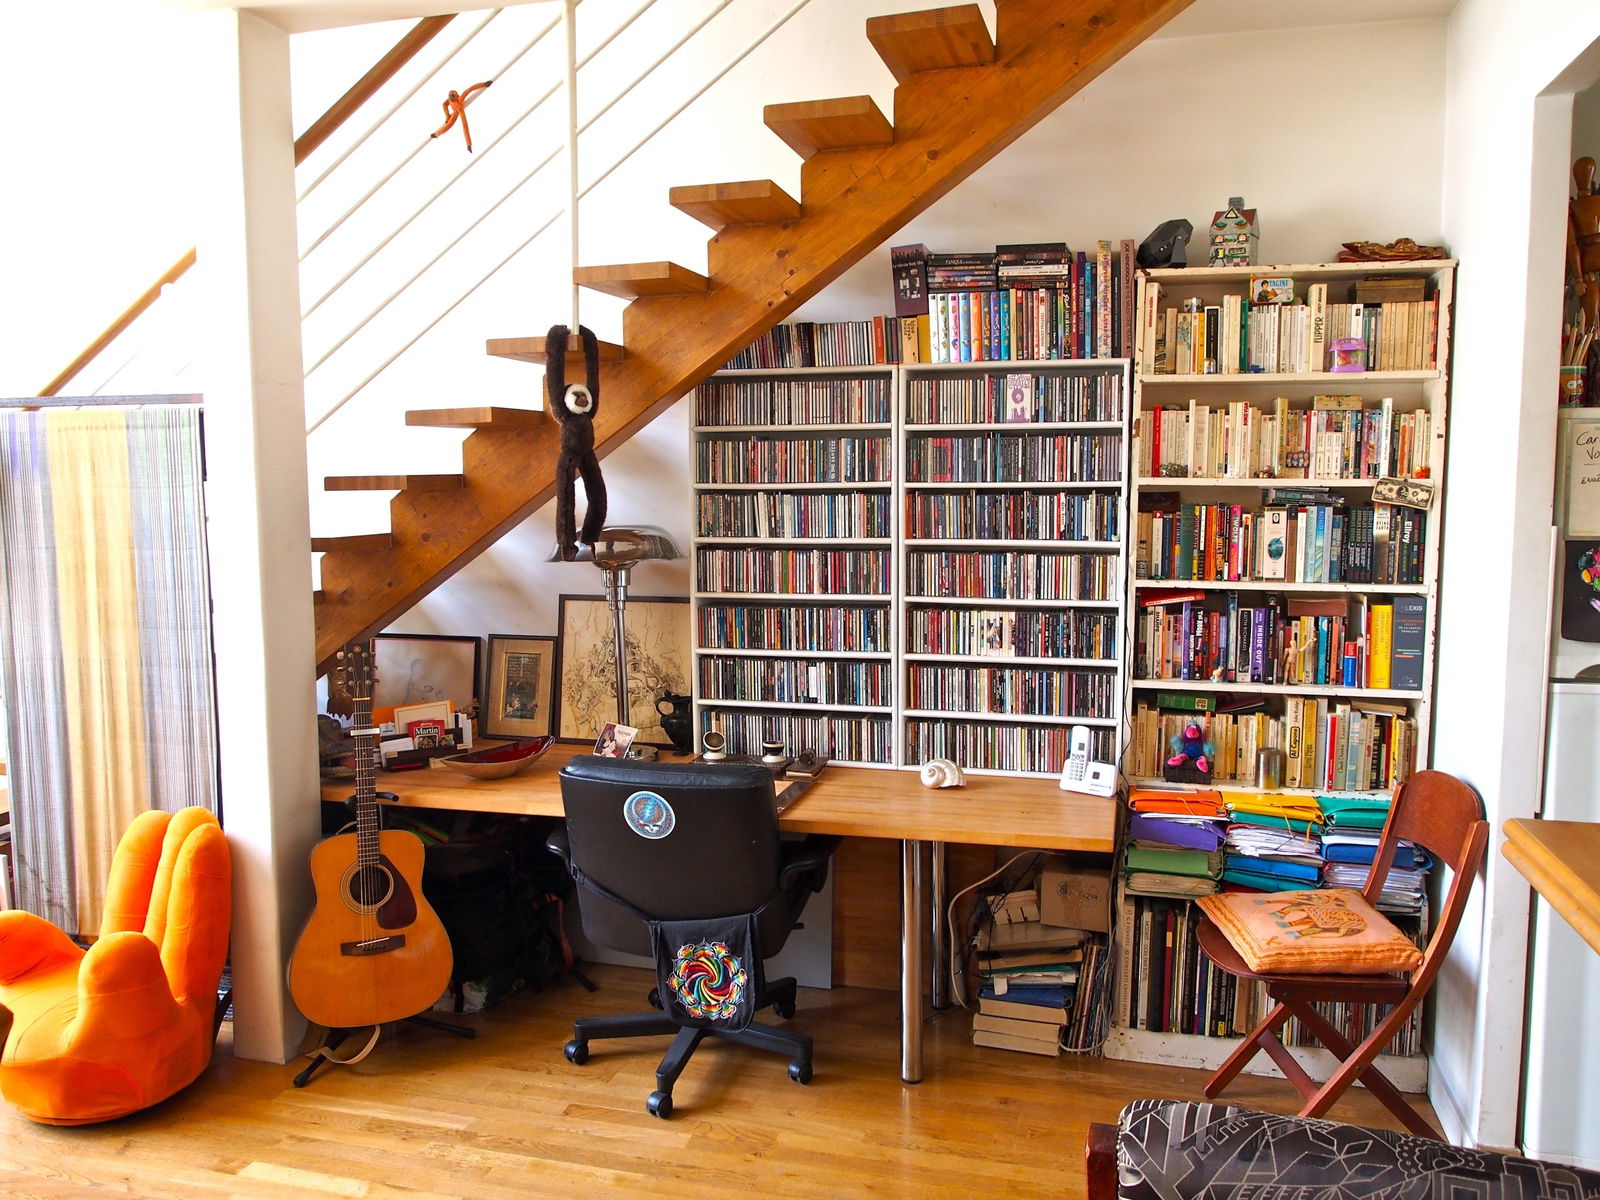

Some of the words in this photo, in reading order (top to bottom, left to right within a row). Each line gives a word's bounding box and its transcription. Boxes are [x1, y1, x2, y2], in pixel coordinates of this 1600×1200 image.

[1313, 317, 1324, 343] FLIPPER
[1402, 521, 1412, 544] Ellroy
[416, 726, 438, 734] Martin
[1291, 728, 1299, 749] Capone
